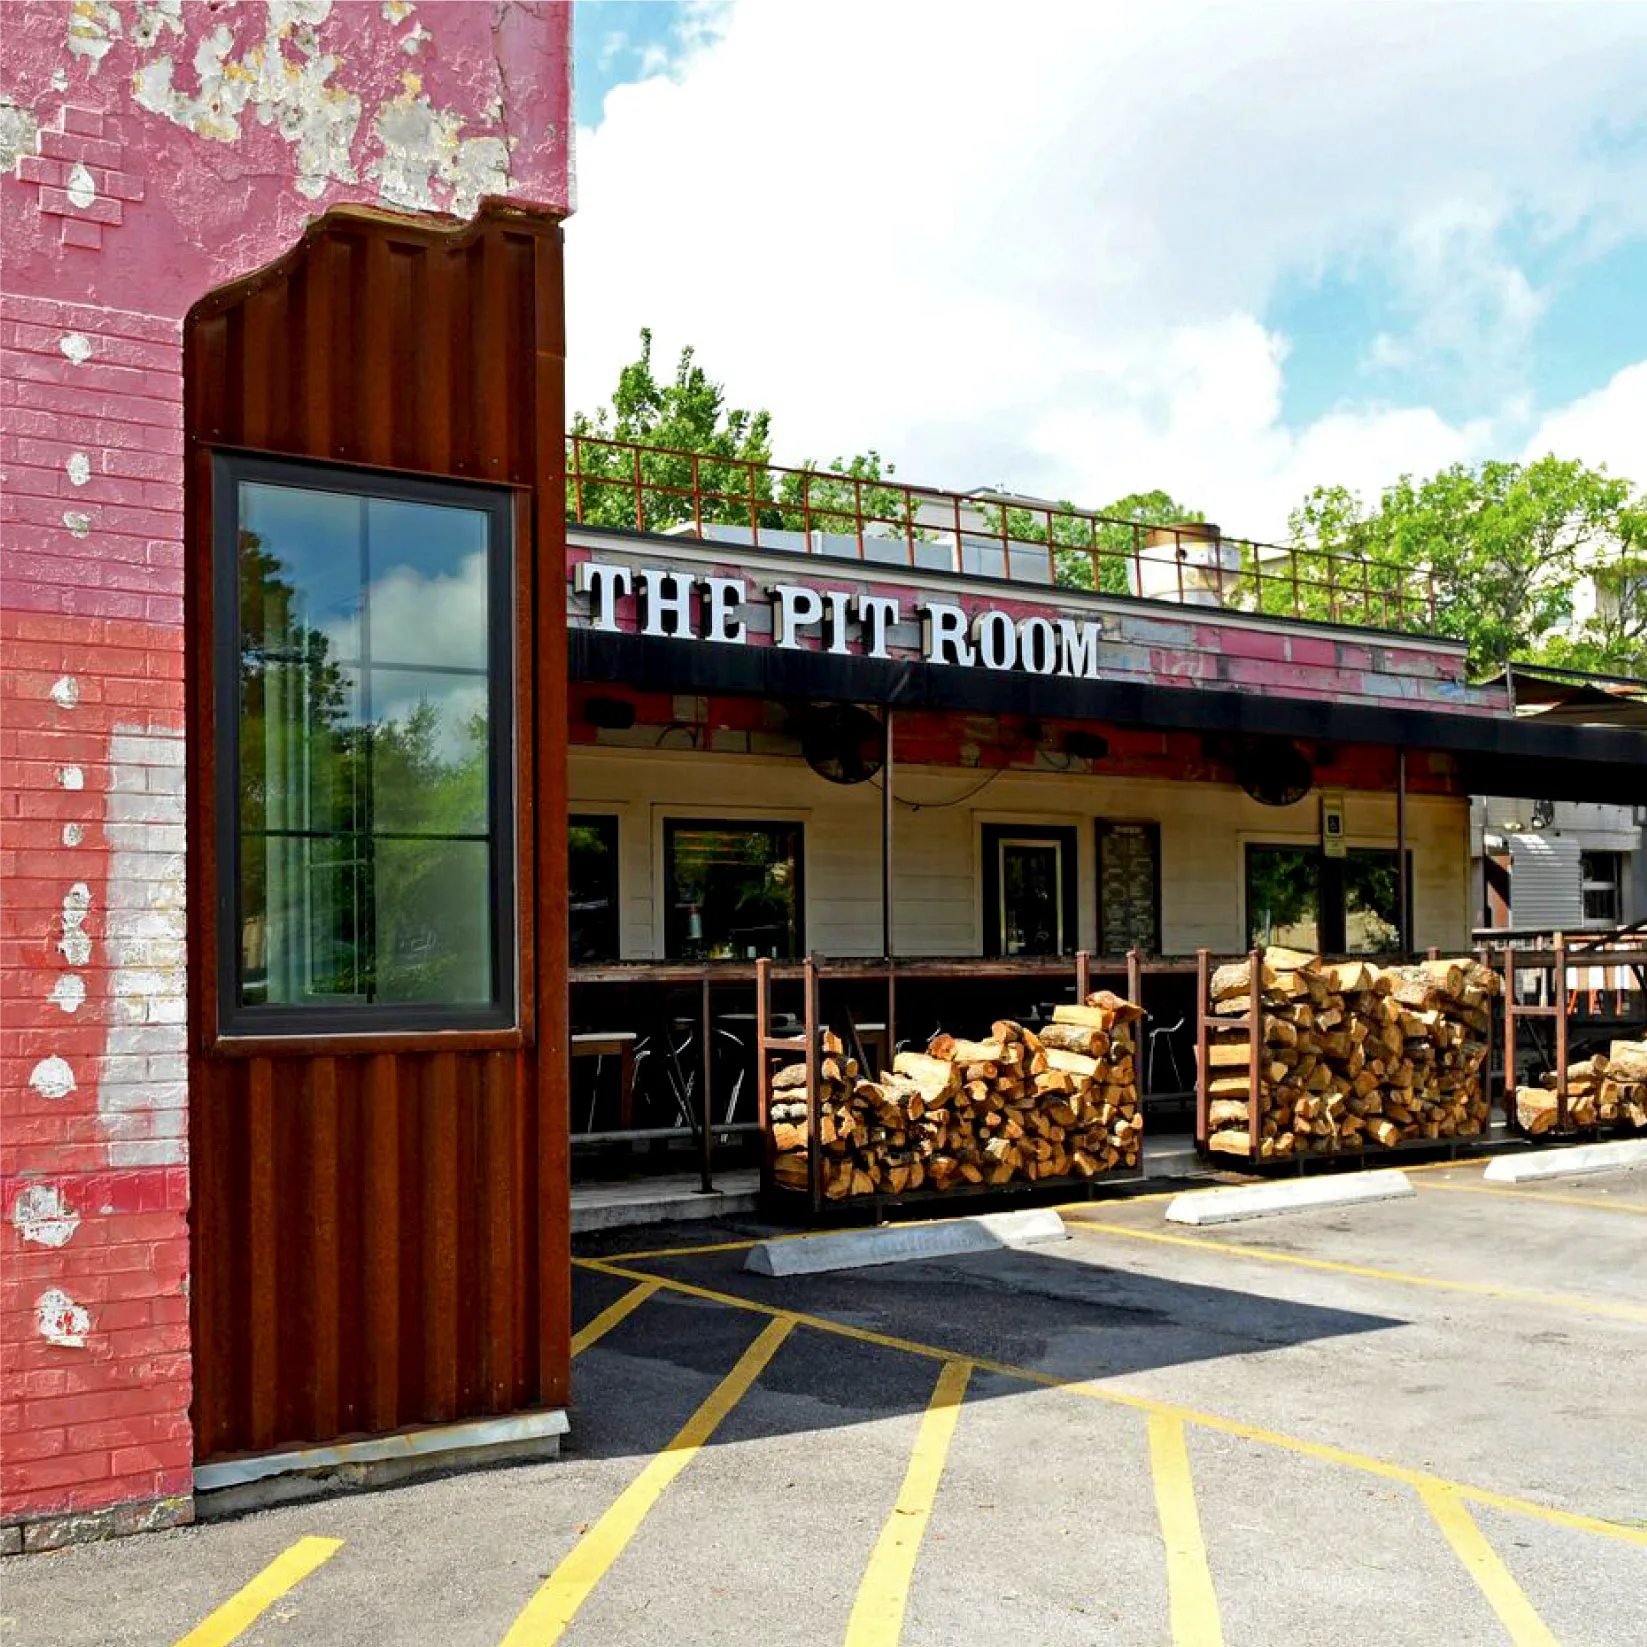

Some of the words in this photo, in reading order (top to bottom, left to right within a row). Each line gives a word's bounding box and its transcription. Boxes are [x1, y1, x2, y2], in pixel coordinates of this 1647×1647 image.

[583, 563, 747, 644] THE
[775, 584, 899, 659] PIT
[923, 602, 1102, 681] ROOM
